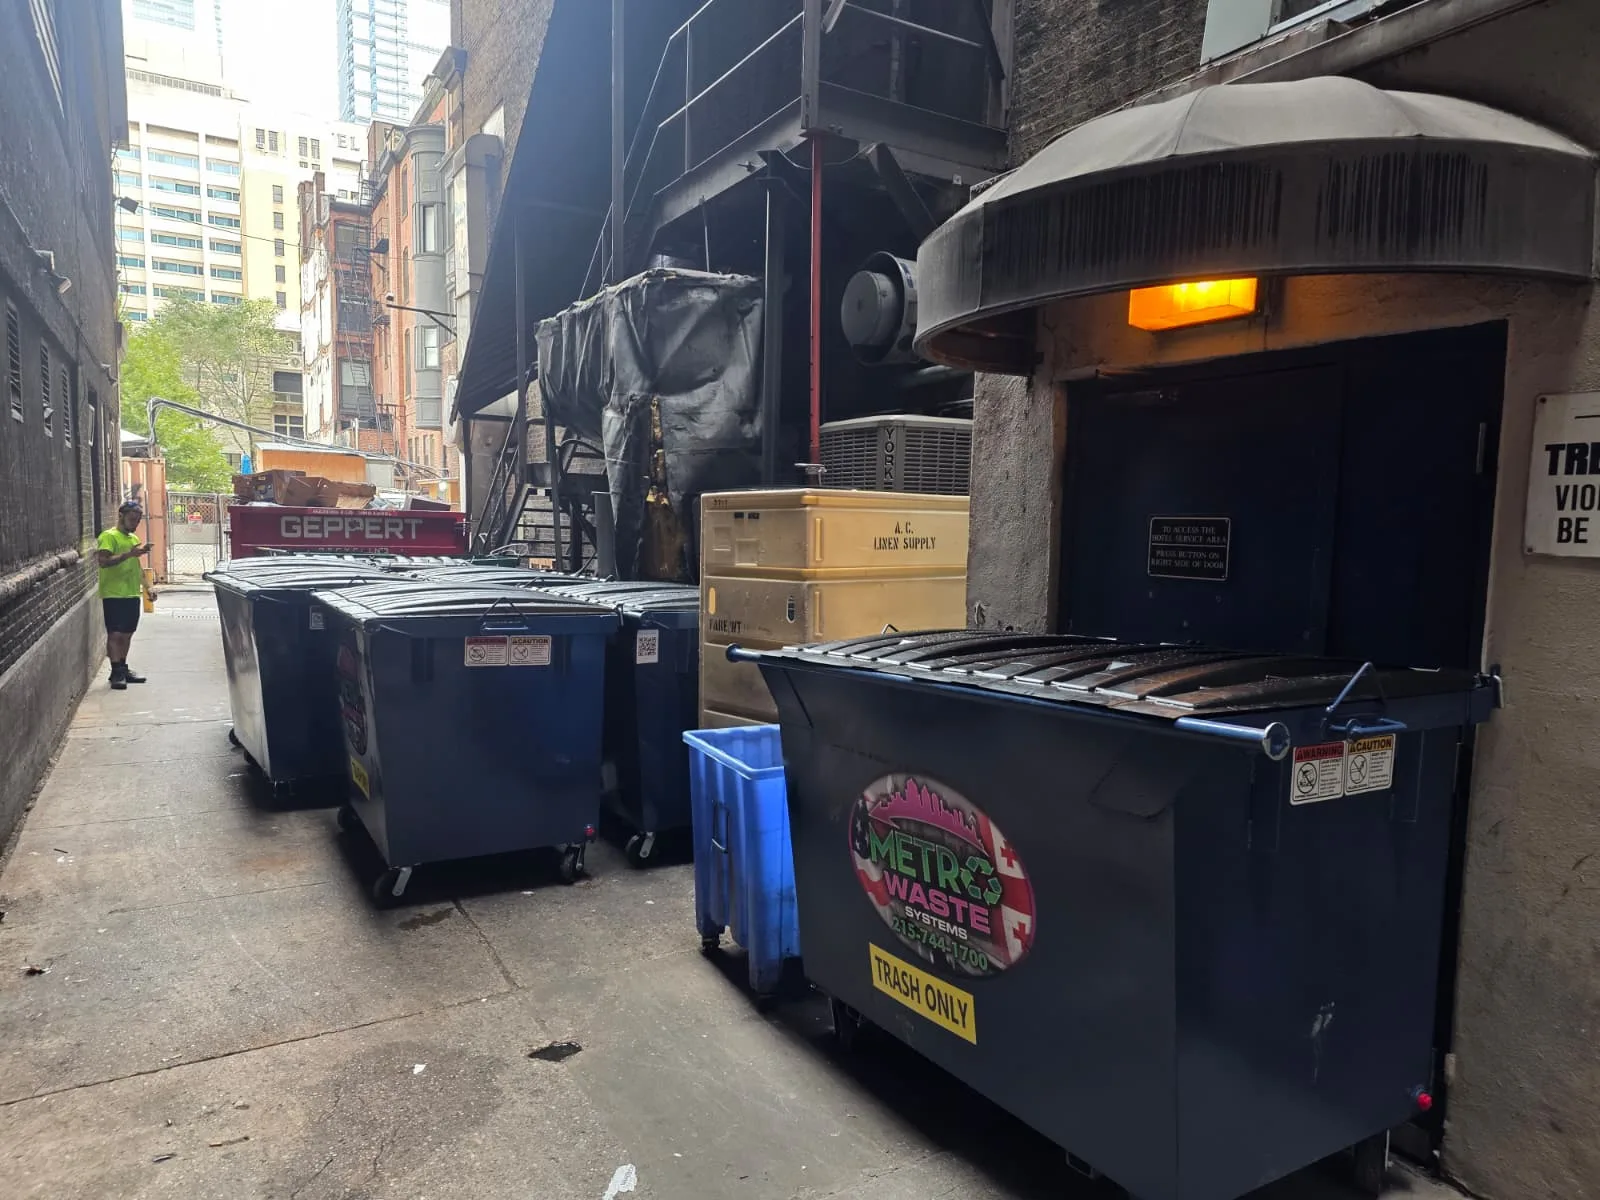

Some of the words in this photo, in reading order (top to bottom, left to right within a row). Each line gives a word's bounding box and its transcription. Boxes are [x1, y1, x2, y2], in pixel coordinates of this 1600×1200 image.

[884, 427, 895, 479] YORK
[1556, 484, 1600, 512] VIO
[280, 516, 423, 540] GEPPERT
[1557, 517, 1589, 543] BE
[874, 536, 899, 550] LINEN
[903, 536, 936, 550] SUPPLY
[1304, 744, 1343, 759] WARNING
[1355, 738, 1392, 751] CAUTION
[883, 870, 992, 935] WASTE
[905, 905, 968, 940] SYSTEMS
[892, 916, 988, 970] 215-744-1700
[874, 955, 921, 1004] TRASH
[924, 983, 968, 1029] ONLY
